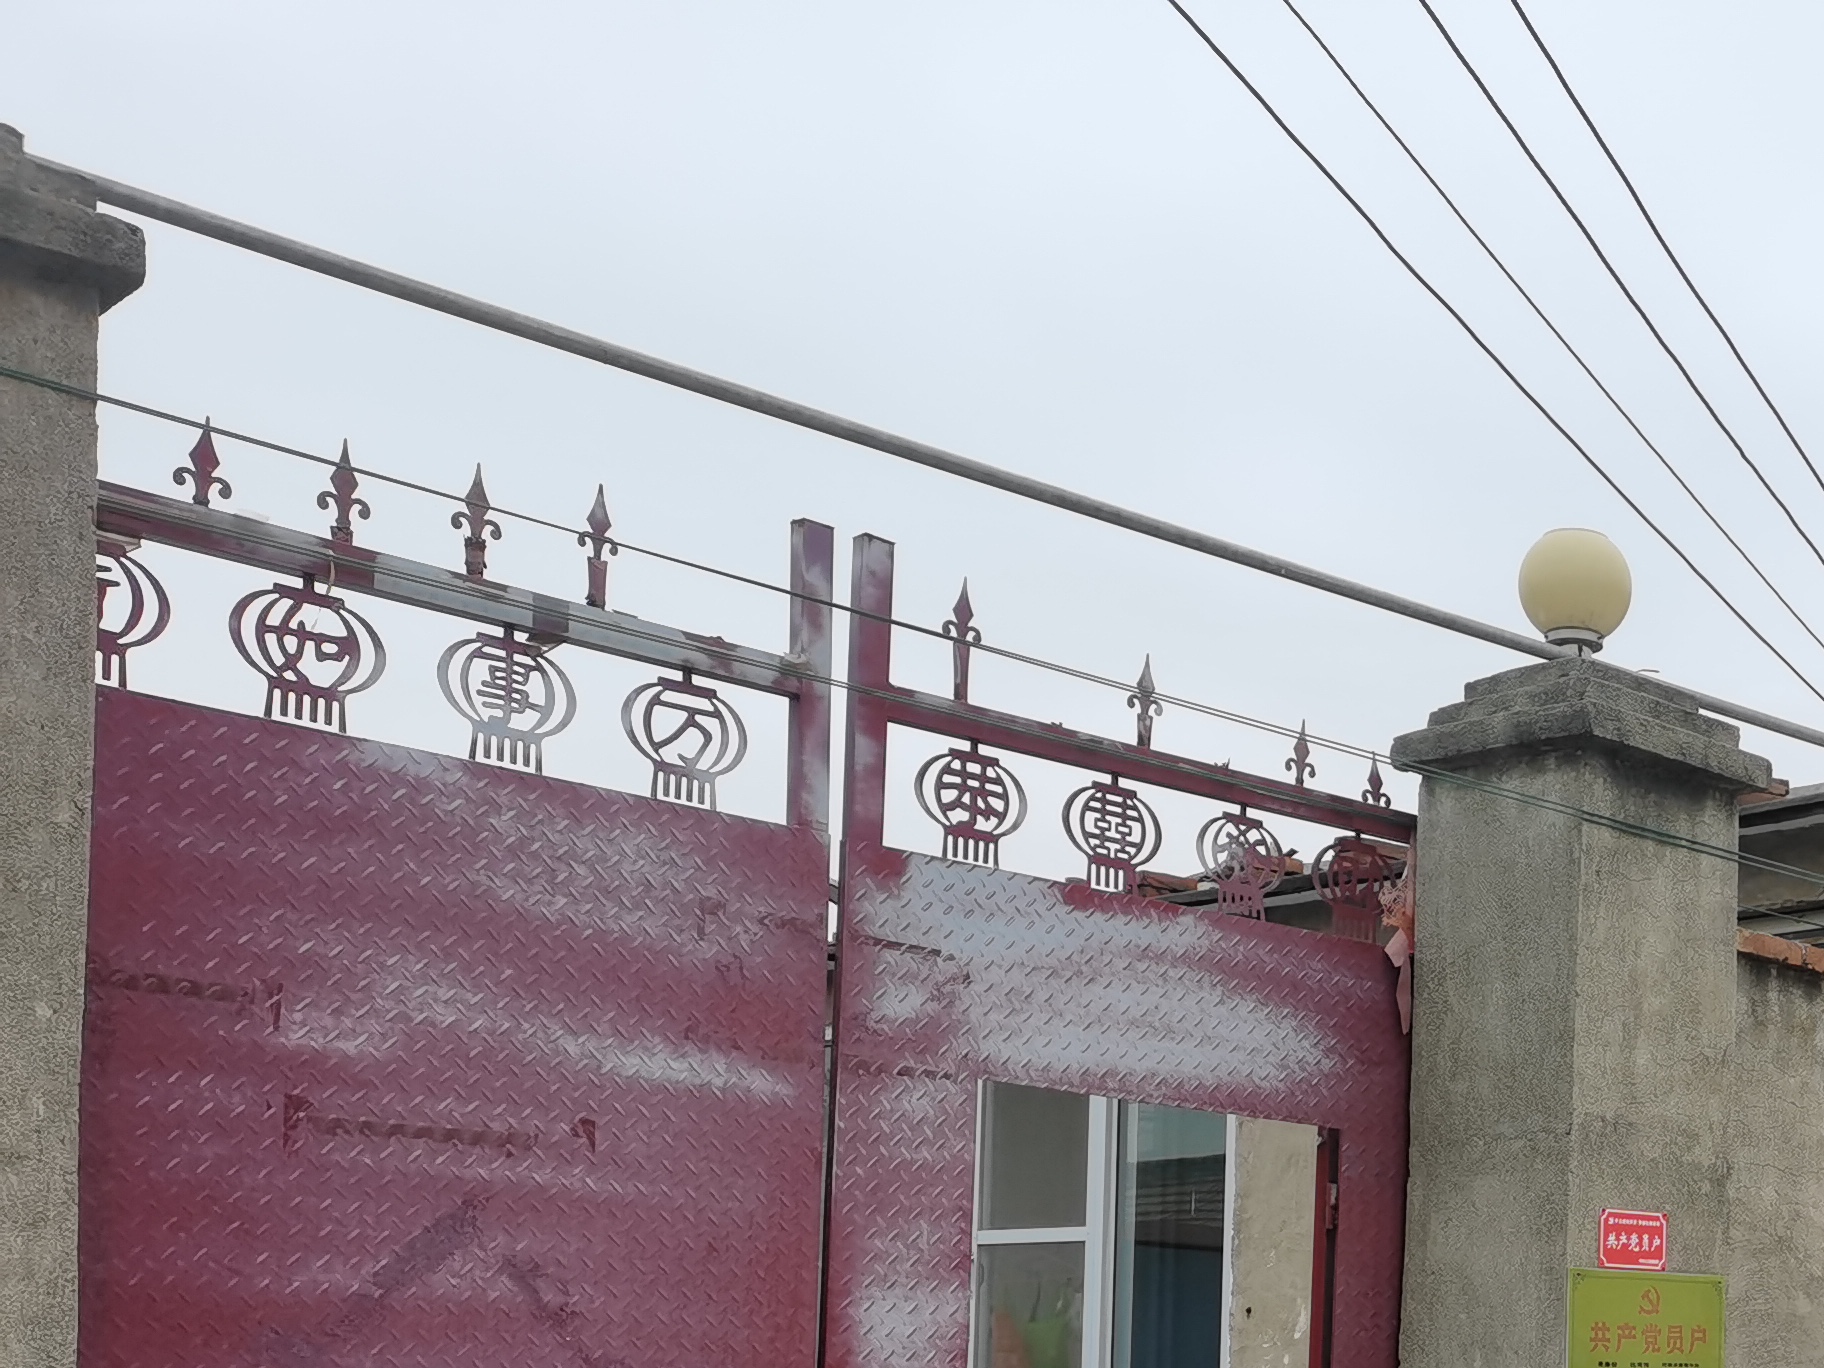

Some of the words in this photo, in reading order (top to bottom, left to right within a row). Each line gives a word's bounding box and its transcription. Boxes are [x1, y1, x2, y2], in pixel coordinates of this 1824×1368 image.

[1605, 1231, 1661, 1252] 共产党员户
[1590, 1321, 1707, 1354] 共产党员户
